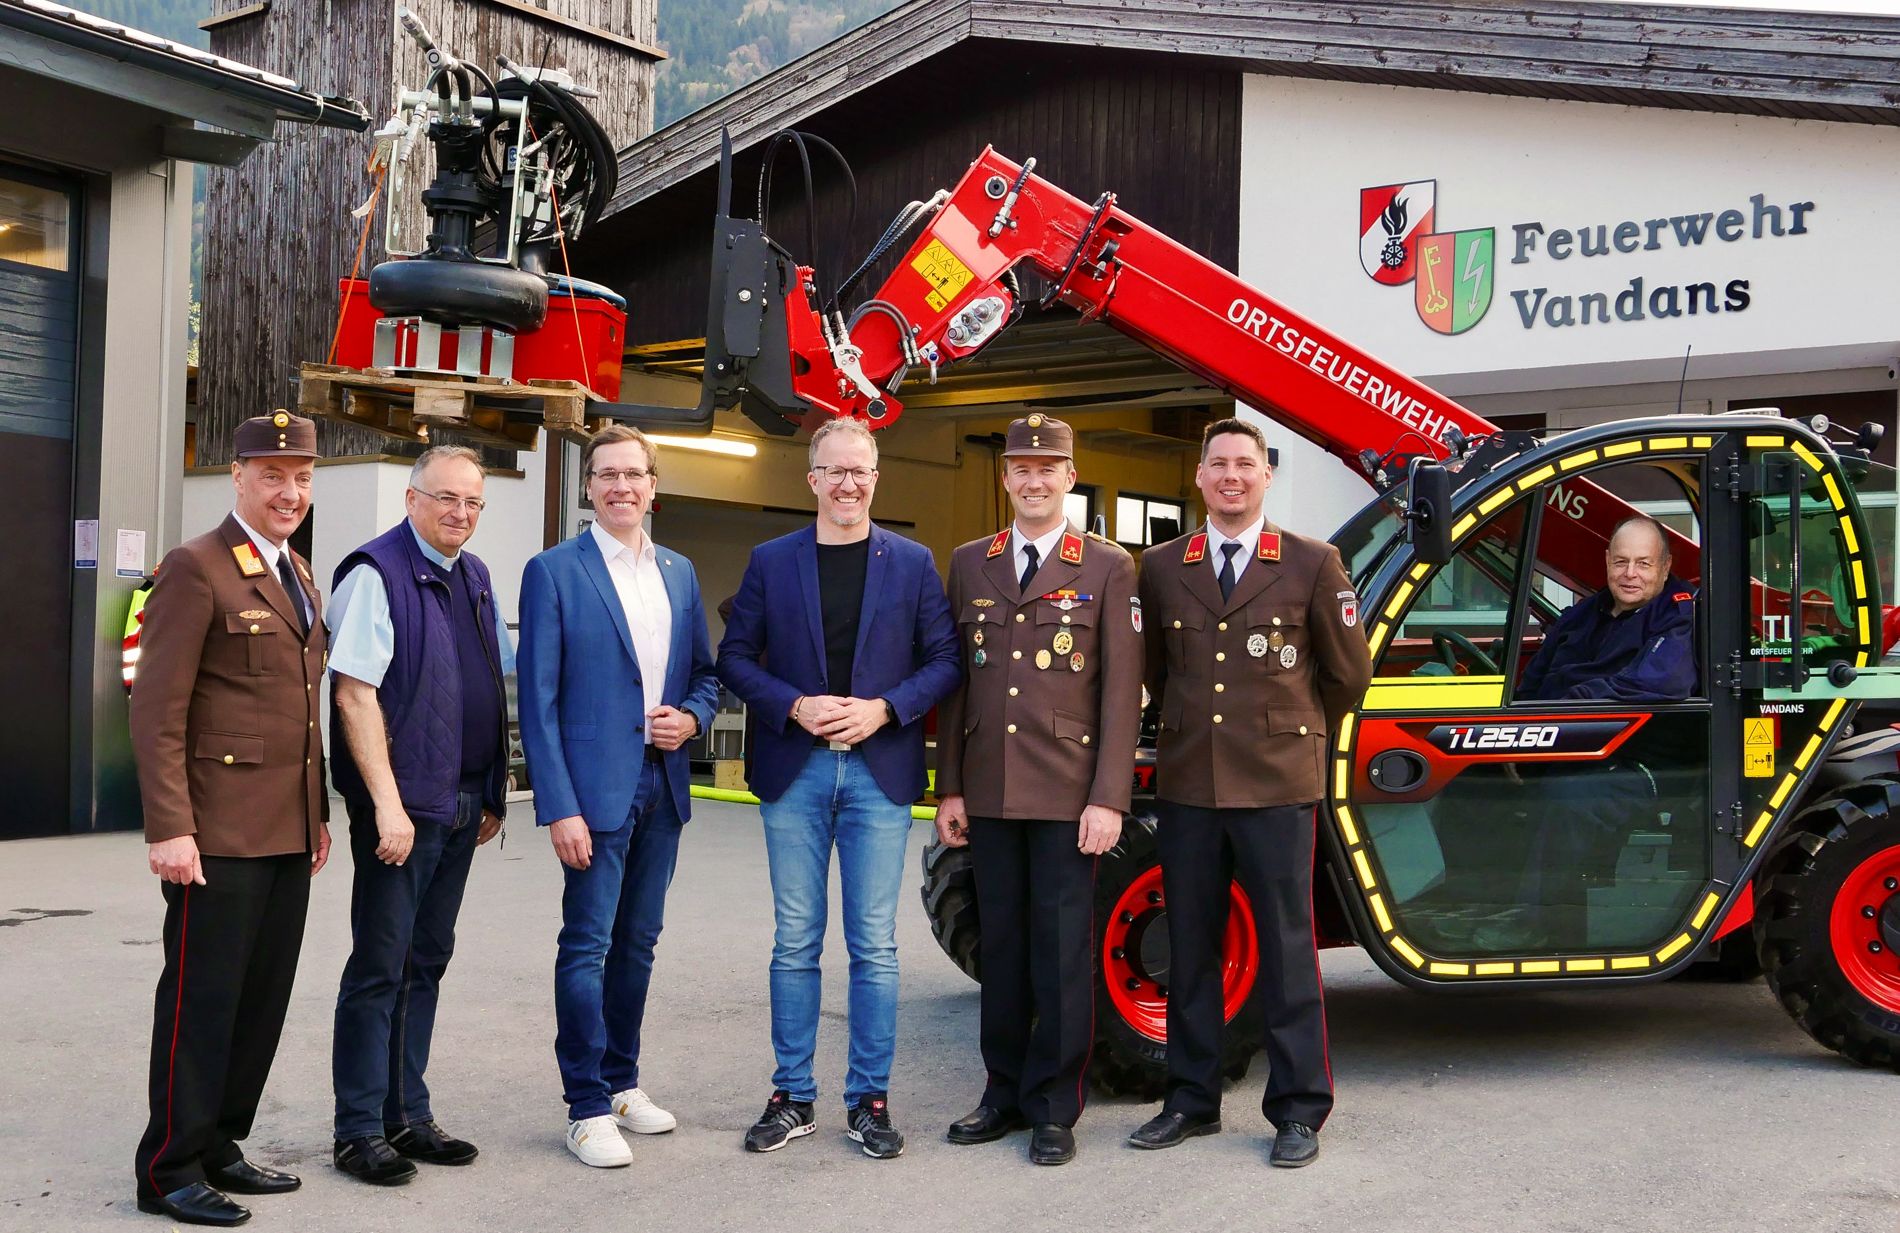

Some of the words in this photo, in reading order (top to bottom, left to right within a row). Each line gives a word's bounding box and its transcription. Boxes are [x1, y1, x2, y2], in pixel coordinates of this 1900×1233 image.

[1511, 193, 1815, 264] Feuerwehr
[1510, 276, 1751, 329] Vandans
[1760, 704, 1805, 714] VANDANS
